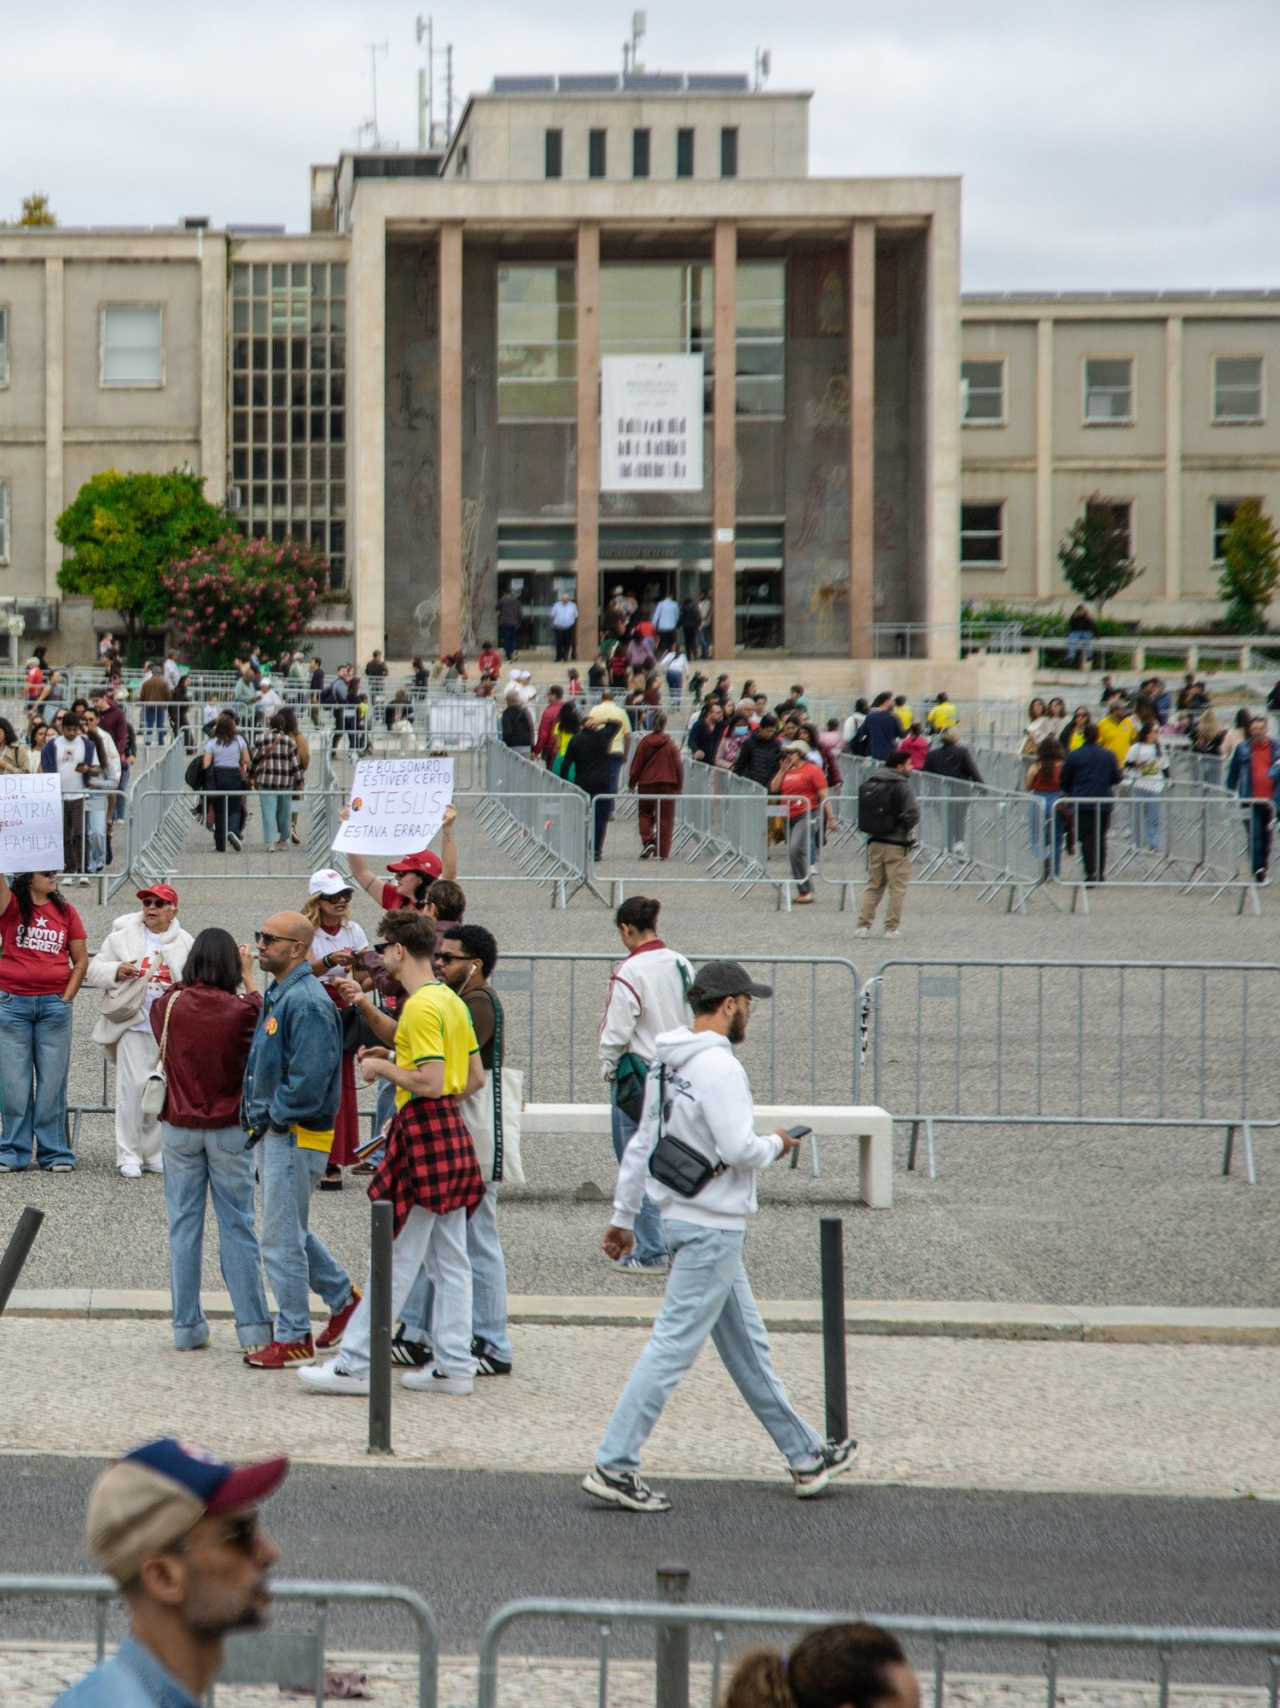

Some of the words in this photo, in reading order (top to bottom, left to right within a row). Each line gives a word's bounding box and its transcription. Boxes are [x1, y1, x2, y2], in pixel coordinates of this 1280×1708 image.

[358, 761, 375, 774] SE
[376, 759, 440, 773] BOLSONARO
[4, 777, 56, 794] DEUS
[363, 774, 409, 786] ESTIVER
[415, 772, 451, 784] CERTO
[3, 801, 55, 819] PÁTRIA
[368, 791, 443, 815] JESUS
[343, 825, 388, 838] ESTAVA
[393, 823, 440, 837] ERRADO
[4, 832, 58, 852] FAMÍLIA
[27, 926, 58, 942] VOTO
[57, 930, 65, 944] É
[16, 935, 63, 954] SECRETO
